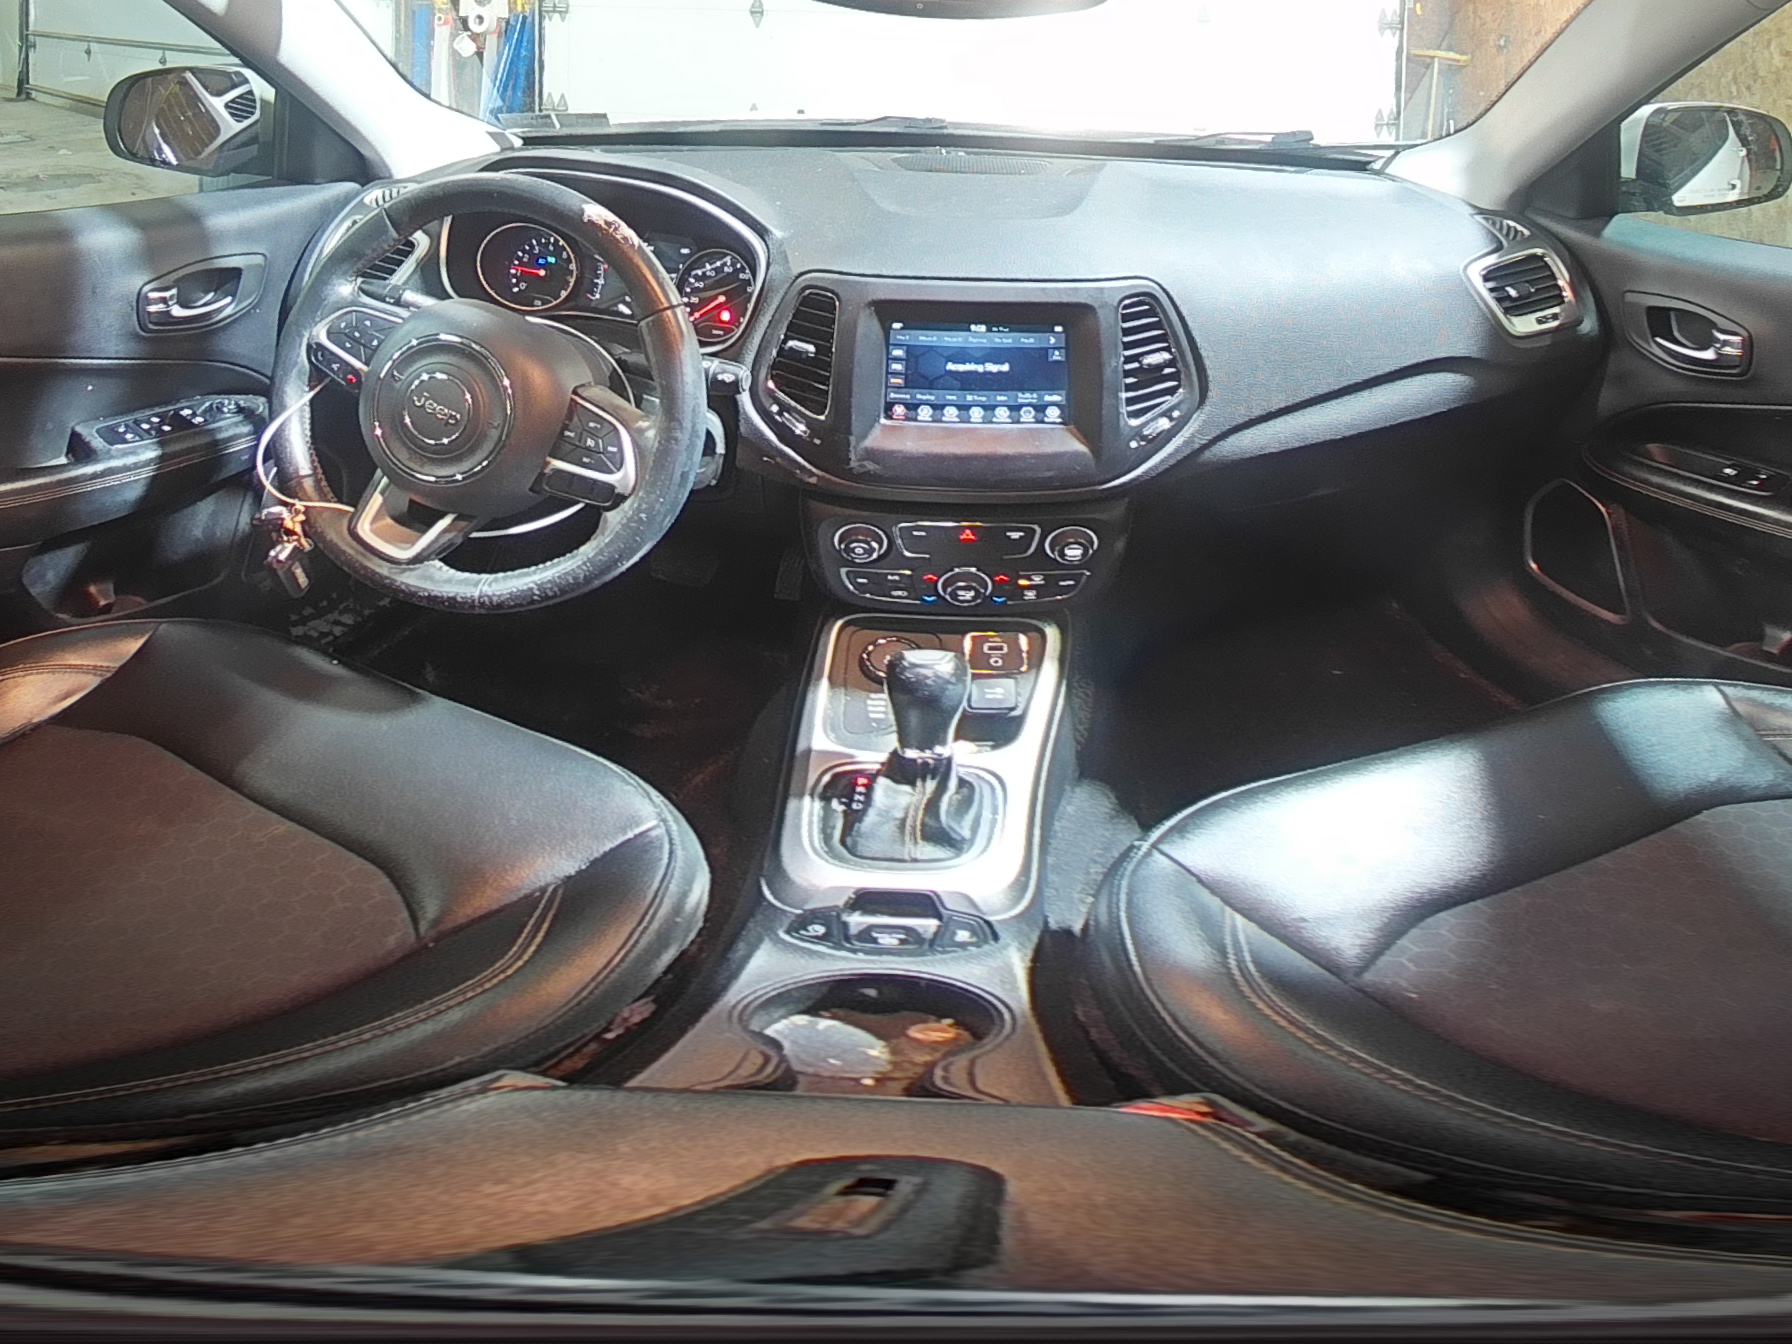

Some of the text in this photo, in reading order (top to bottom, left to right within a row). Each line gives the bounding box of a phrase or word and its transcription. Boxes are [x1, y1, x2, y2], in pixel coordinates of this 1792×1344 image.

[945, 361, 1010, 373] Acquiring Signal
[413, 391, 462, 427] Jeep
